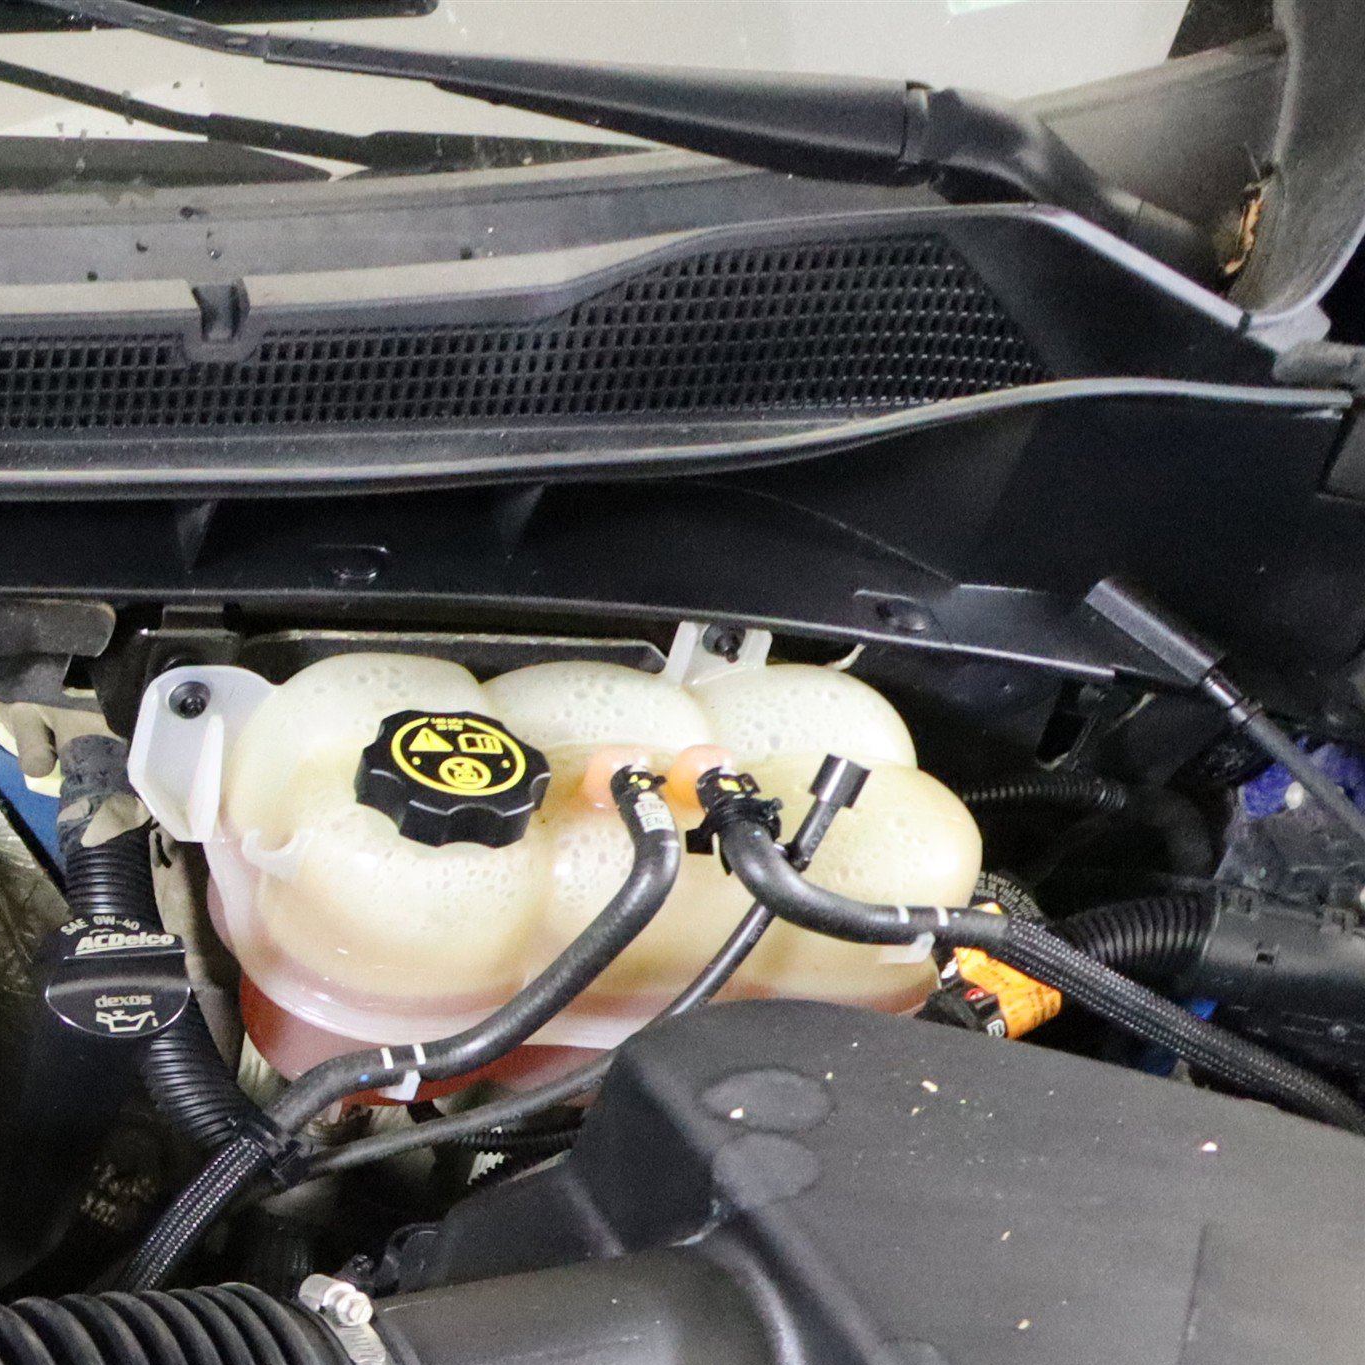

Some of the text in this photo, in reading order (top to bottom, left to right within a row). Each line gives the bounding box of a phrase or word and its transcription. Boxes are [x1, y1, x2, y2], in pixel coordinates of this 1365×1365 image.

[60, 915, 140, 936] SAE 0W-40
[74, 931, 176, 954] ACDelco
[94, 994, 153, 1008] dexos
